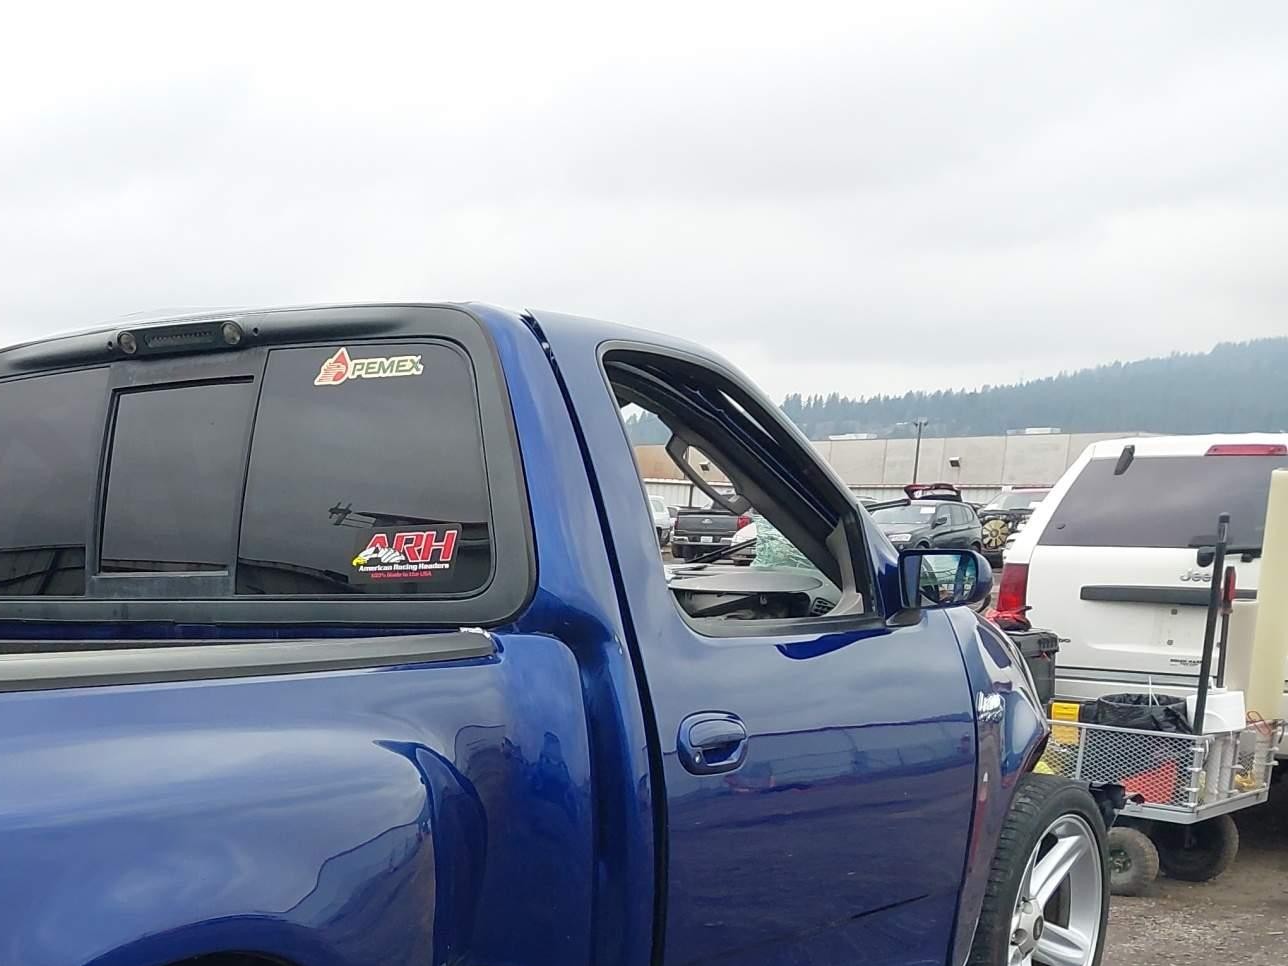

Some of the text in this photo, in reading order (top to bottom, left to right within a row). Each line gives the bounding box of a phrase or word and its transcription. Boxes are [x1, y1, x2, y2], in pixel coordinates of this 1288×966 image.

[351, 357, 421, 377] PEMEX
[364, 529, 458, 563] ARH
[358, 562, 450, 573] American Racing Headers
[1180, 568, 1212, 582] Jee
